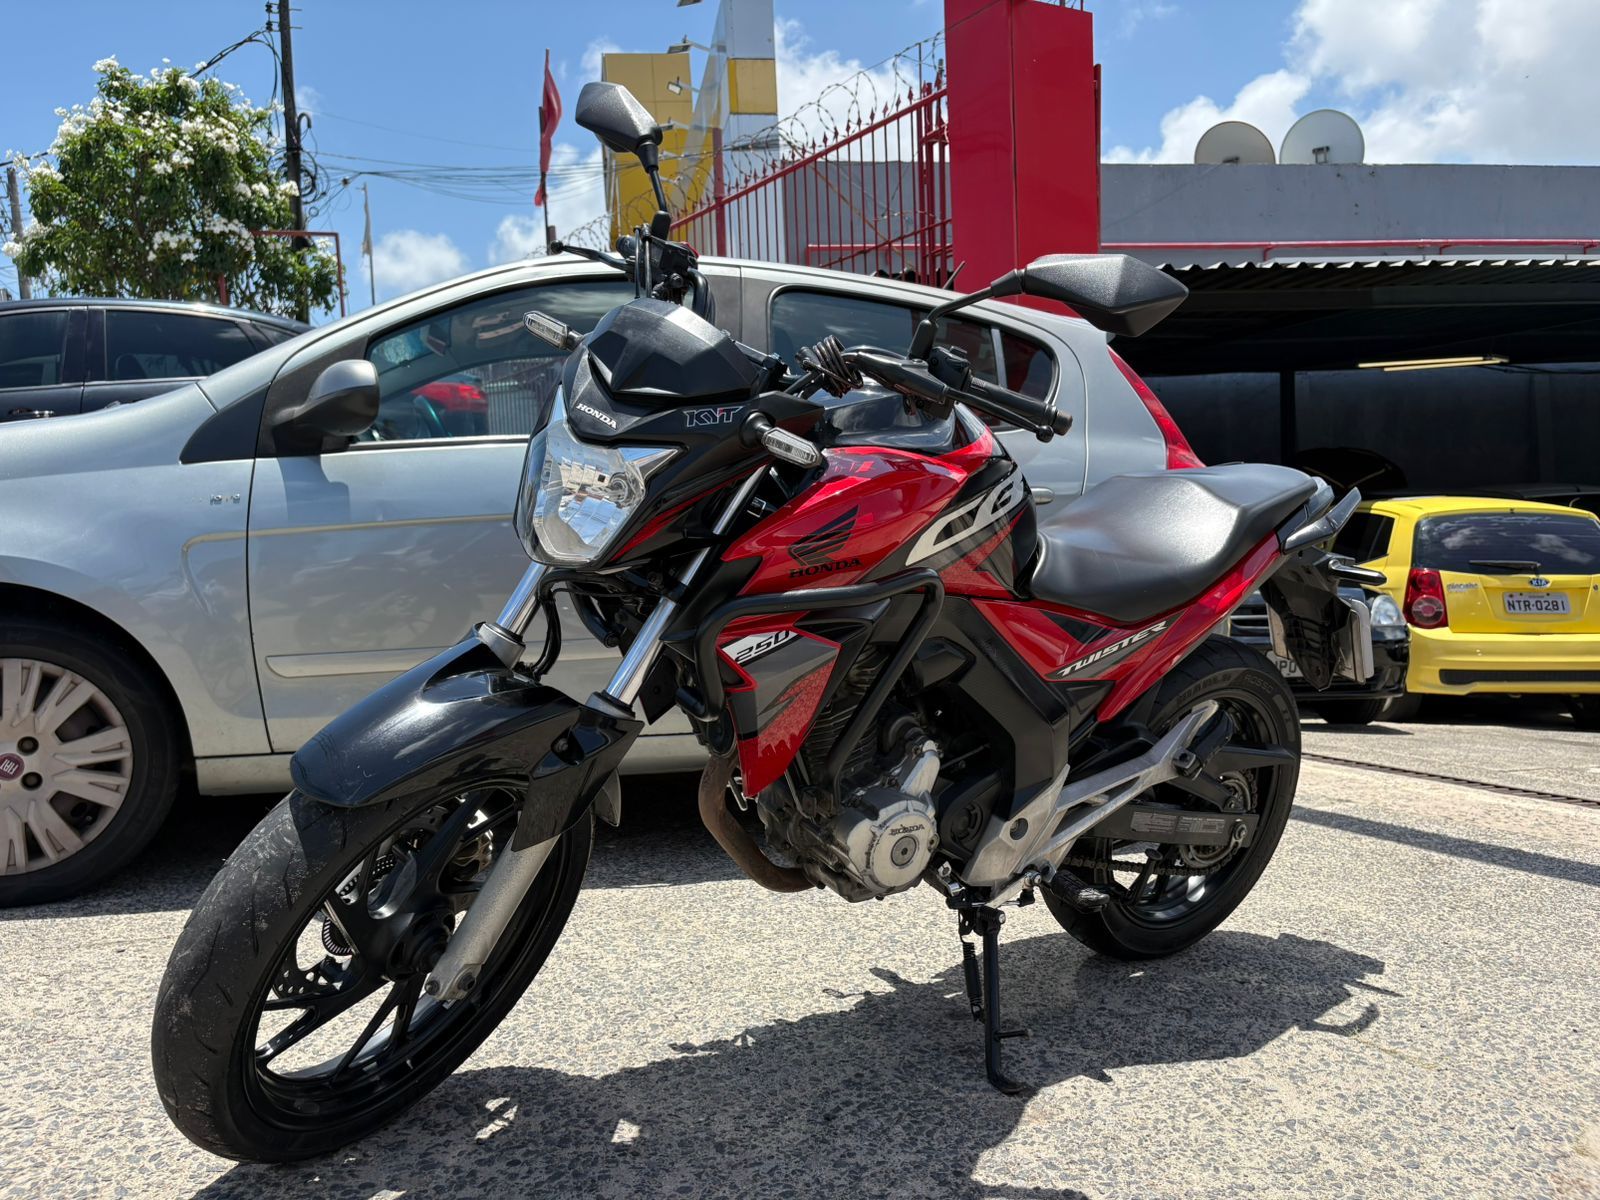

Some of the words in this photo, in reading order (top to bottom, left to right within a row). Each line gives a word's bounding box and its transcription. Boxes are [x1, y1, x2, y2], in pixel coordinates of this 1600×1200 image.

[576, 402, 617, 430] HONDA
[683, 405, 744, 427] KYT
[905, 465, 1025, 567] CB
[789, 557, 864, 579] HONDA
[1530, 578, 1549, 587] KIA
[735, 630, 790, 662] 250
[1056, 620, 1168, 677] TWISTER
[0, 759, 19, 775] FIAT
[889, 823, 925, 836] HONDA
